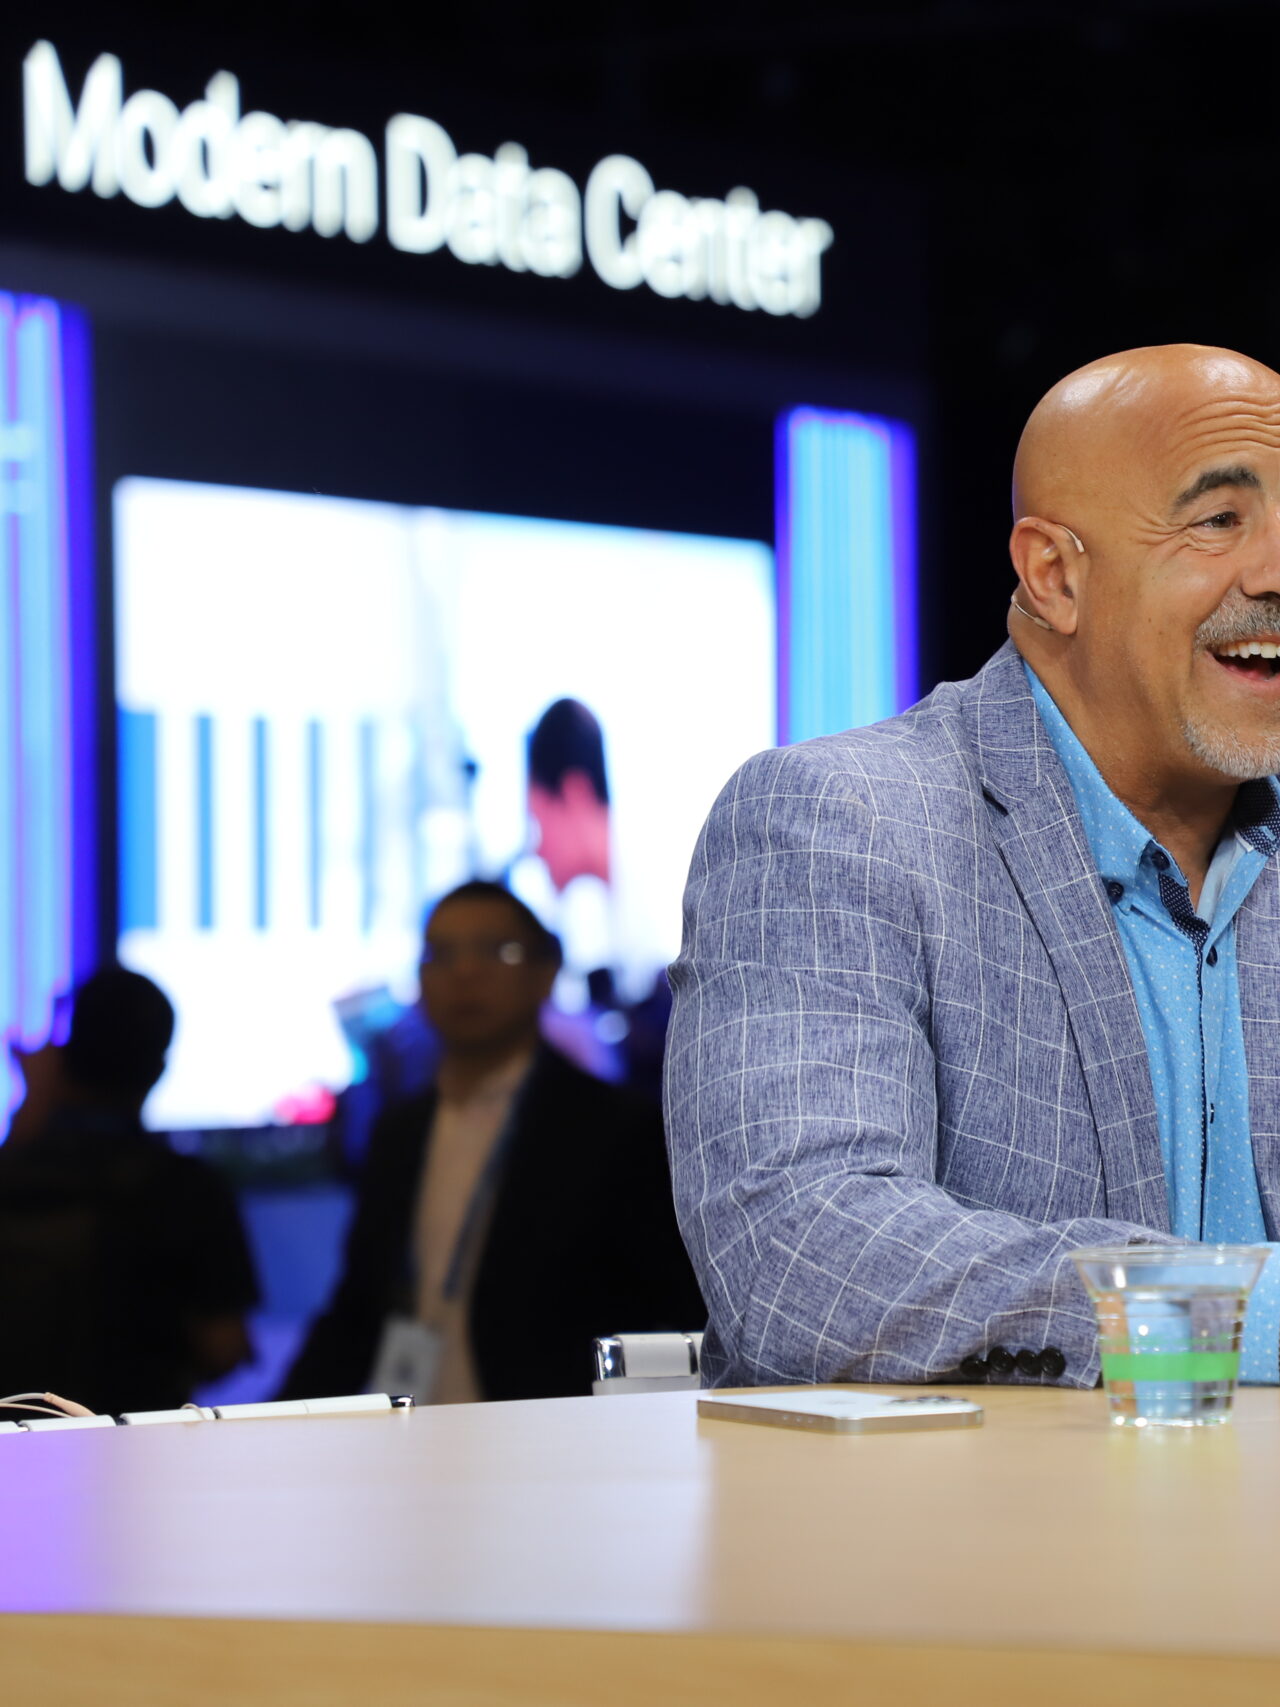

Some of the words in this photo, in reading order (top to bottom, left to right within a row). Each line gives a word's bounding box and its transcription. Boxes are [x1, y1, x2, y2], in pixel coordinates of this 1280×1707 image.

[23, 40, 378, 243] Modern
[385, 113, 582, 278] Data
[584, 155, 833, 317] Center
